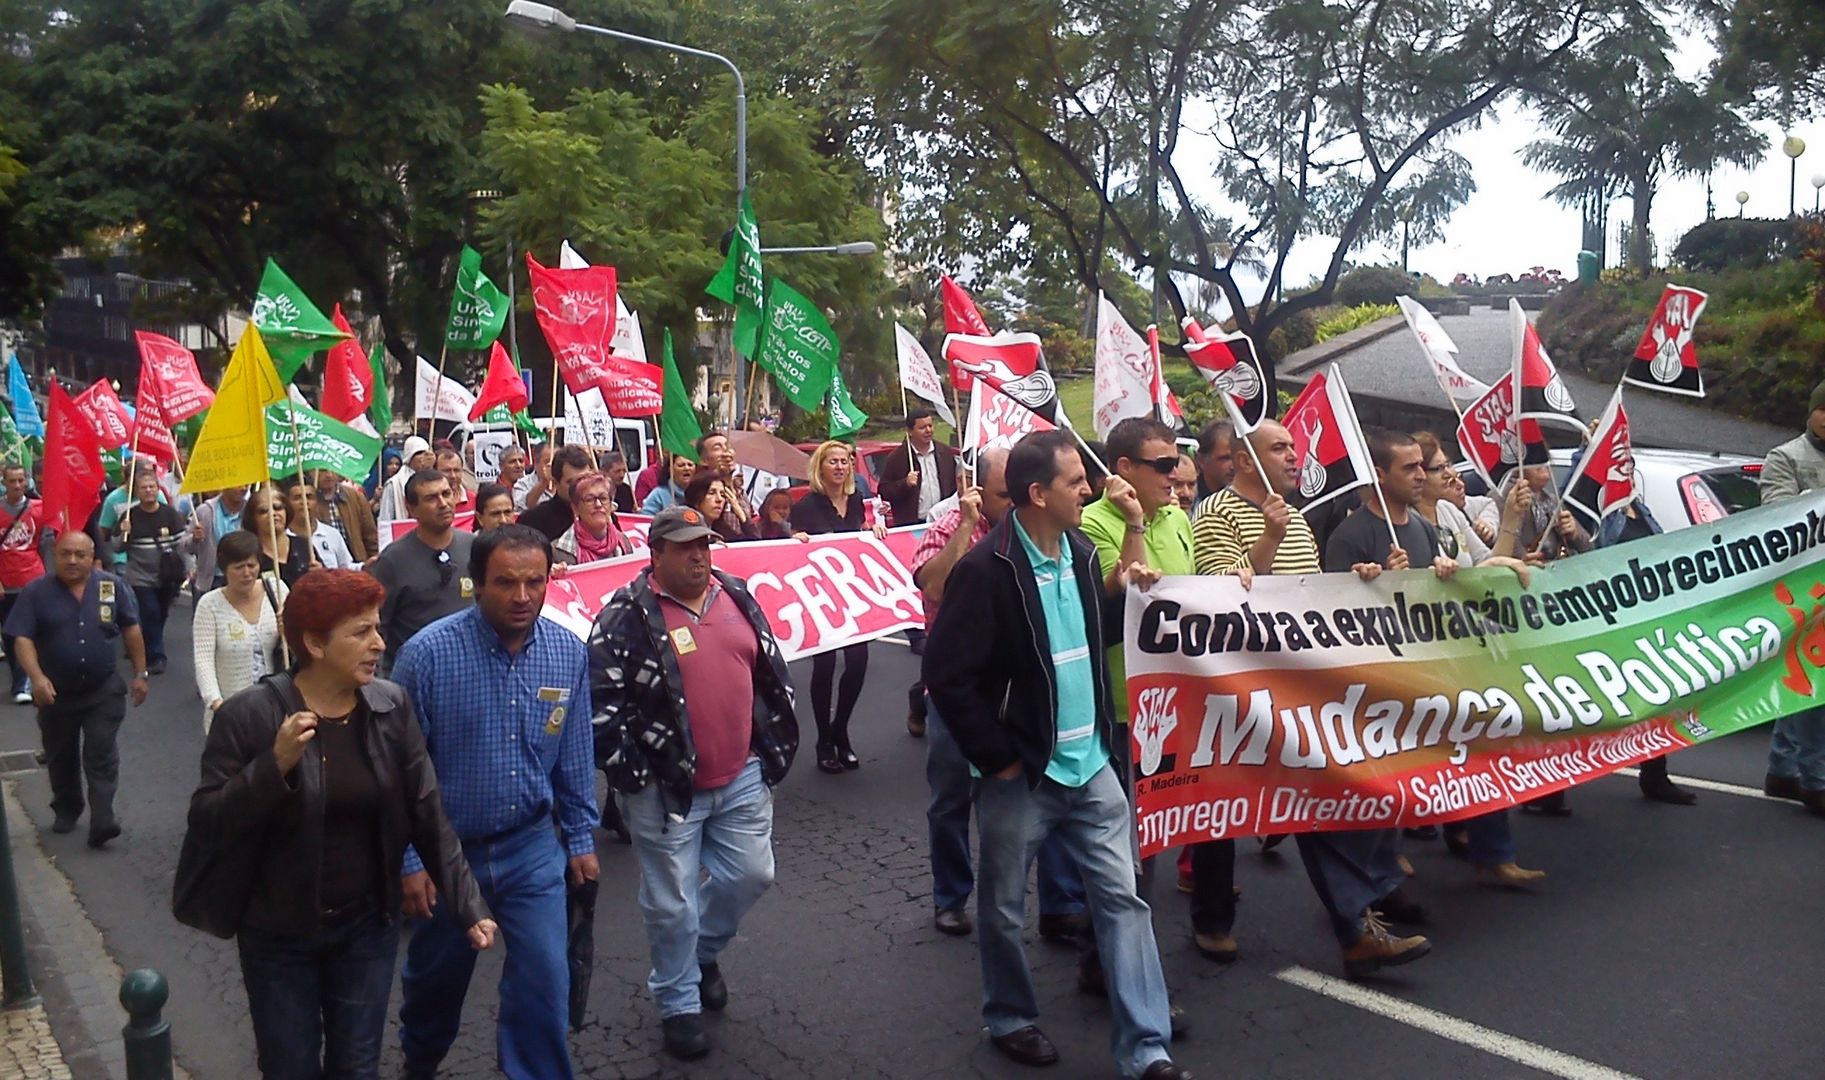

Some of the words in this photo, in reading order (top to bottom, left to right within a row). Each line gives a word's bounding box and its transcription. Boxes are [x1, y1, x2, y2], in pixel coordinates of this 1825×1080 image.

[787, 349, 812, 369] dos
[990, 394, 1036, 433] STAL
[1474, 387, 1512, 435] STAL
[476, 469, 500, 478] troik
[1137, 599, 1305, 657] Contra
[1303, 609, 1340, 649] a
[1340, 589, 1519, 657] exploração
[1520, 593, 1544, 630] e
[1137, 687, 1178, 731] STAL
[1190, 683, 1524, 768] Mudança
[1520, 664, 1604, 733] de
[1575, 616, 1782, 718] Política
[1150, 773, 1200, 793] Madeira
[1269, 787, 1395, 824] Direitos
[1410, 764, 1502, 817] Salários
[1498, 749, 1592, 793] Serviços
